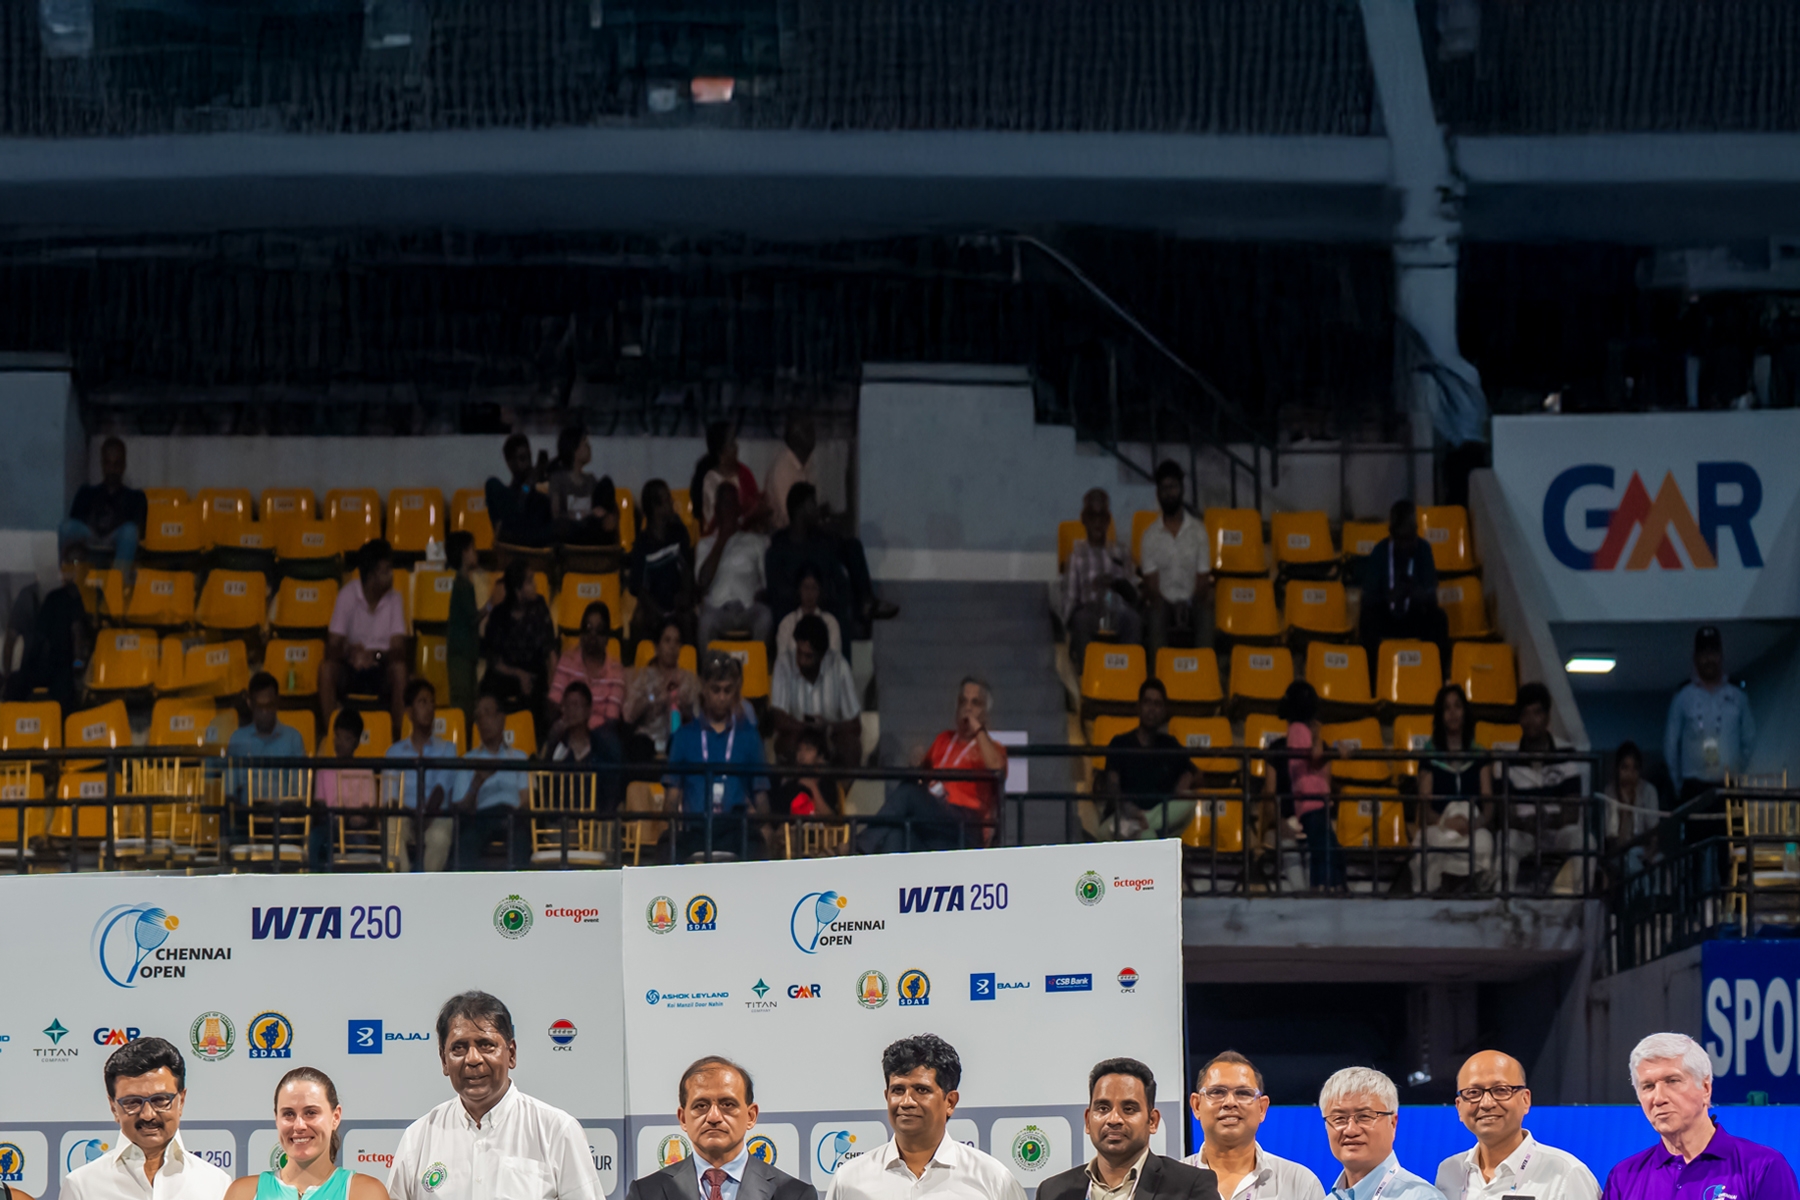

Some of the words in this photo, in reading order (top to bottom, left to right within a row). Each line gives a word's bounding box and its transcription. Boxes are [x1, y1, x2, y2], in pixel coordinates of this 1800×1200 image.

[1543, 462, 1764, 571] GMR
[1114, 878, 1154, 892] octagon
[899, 885, 964, 914] WTA
[970, 883, 1008, 911] 250
[251, 906, 342, 940] WTA
[350, 905, 402, 939] 250
[546, 907, 598, 924] octagon
[830, 920, 885, 932] CHENNAI
[820, 935, 852, 946] OPEN
[156, 948, 232, 961] CHENNAI
[140, 966, 186, 978] OPEN
[1056, 978, 1069, 986] CSB
[1070, 976, 1089, 986] Bank
[788, 984, 821, 999] GMR
[1706, 977, 1800, 1077] SPO
[93, 1026, 141, 1046] GMR
[385, 1032, 430, 1041] BAJAJ
[33, 1048, 78, 1056] TITAN
[252, 1050, 286, 1058] SDAT
[358, 1154, 394, 1168] octag
